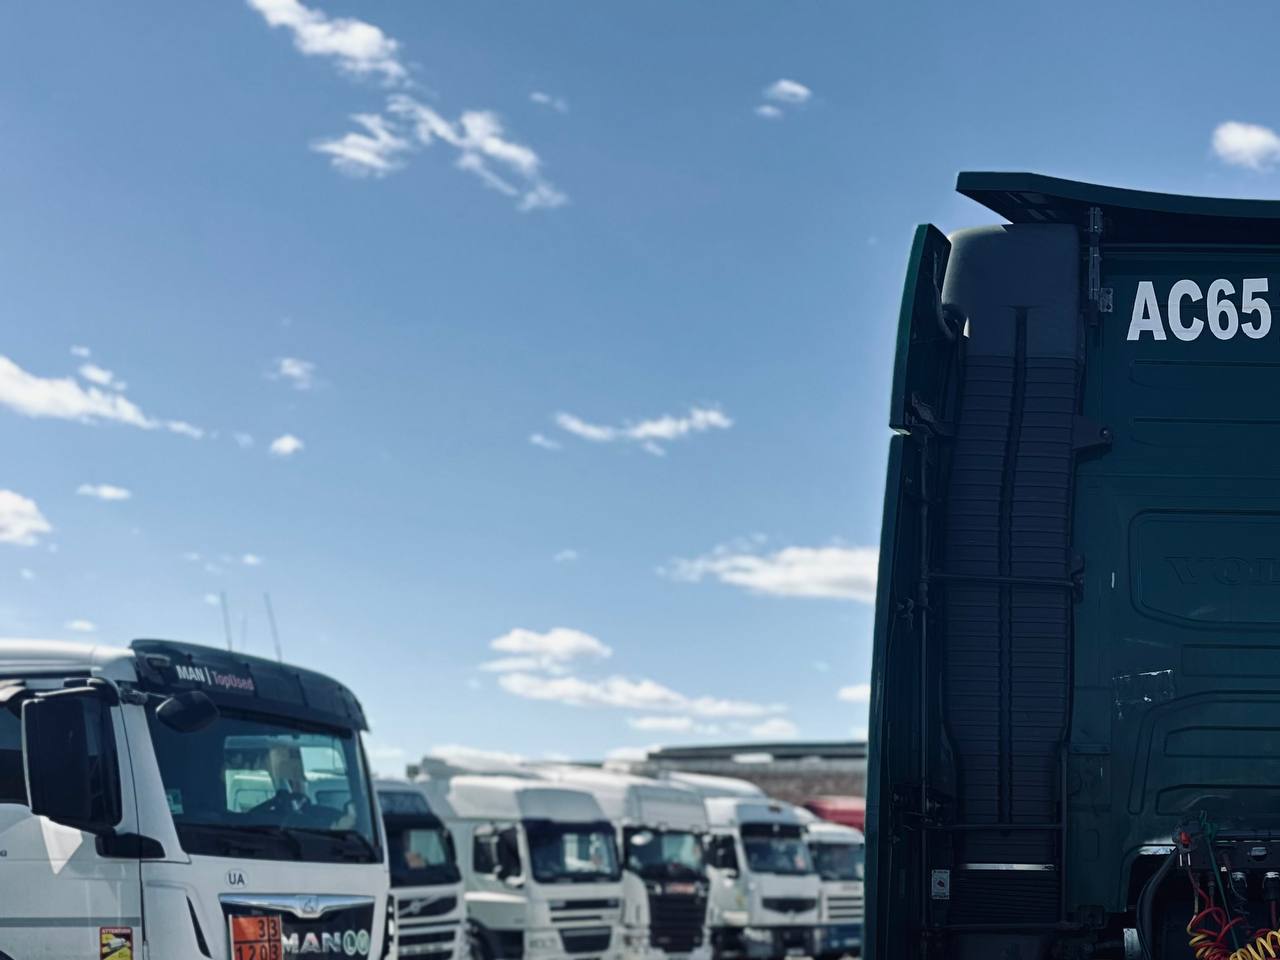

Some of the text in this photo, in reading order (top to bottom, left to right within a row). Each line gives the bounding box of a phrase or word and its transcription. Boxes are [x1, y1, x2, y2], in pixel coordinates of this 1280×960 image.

[176, 664, 255, 691] MAN TopUsed
[228, 873, 245, 885] UA
[257, 918, 279, 939] 33
[281, 931, 342, 955] MAN
